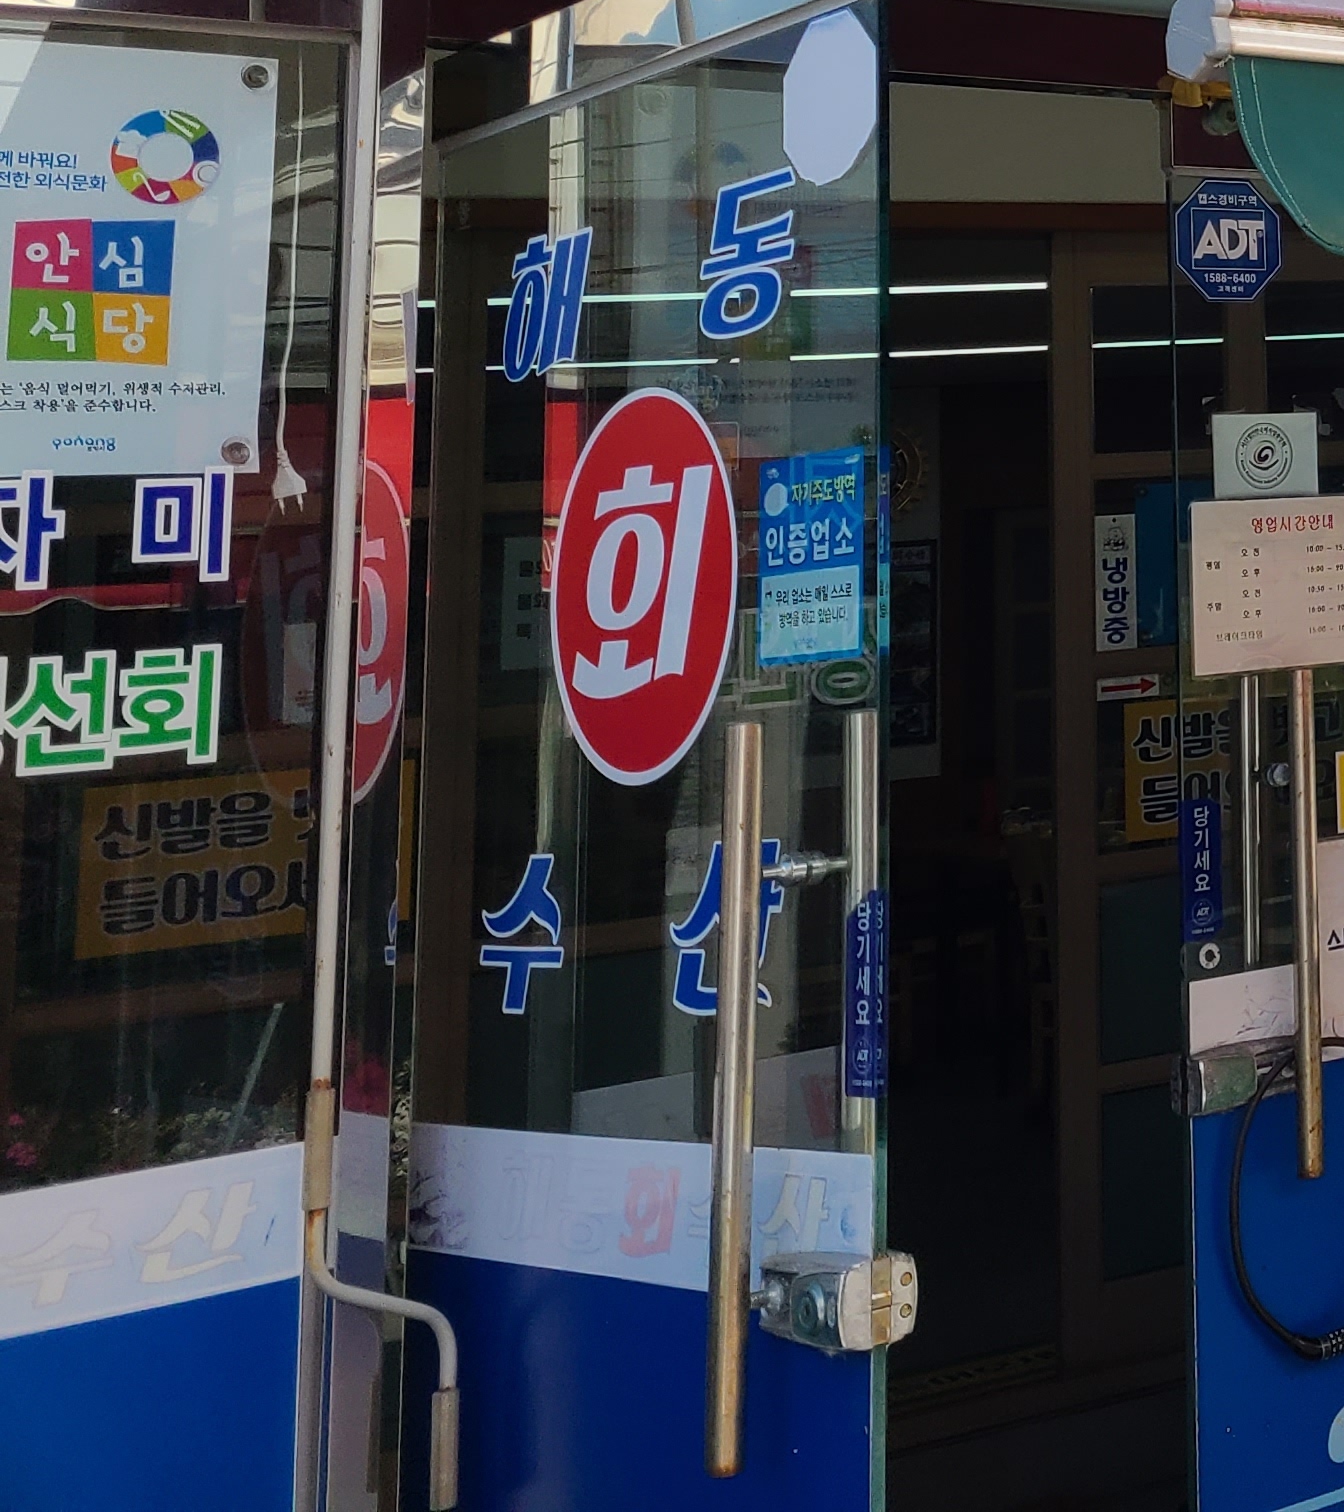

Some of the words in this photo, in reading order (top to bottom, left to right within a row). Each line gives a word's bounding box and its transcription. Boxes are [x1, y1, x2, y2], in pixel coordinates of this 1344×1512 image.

[17, 152, 77, 170] 바꿔요!
[35, 172, 107, 192] 외식문화
[26, 231, 144, 289] 안심
[1193, 219, 1264, 261] ADT
[1204, 272, 1257, 284] 1588-6400
[29, 301, 154, 354] 식당
[765, 518, 854, 567] 인증업소
[1251, 514, 1334, 535] 영업시간안내
[572, 464, 713, 700] 회
[1102, 556, 1130, 644] 냉방중
[0, 642, 223, 777] 선회
[94, 791, 272, 861] 신발을
[1193, 805, 1211, 893] 당기세요
[855, 901, 871, 1025] 당기세요
